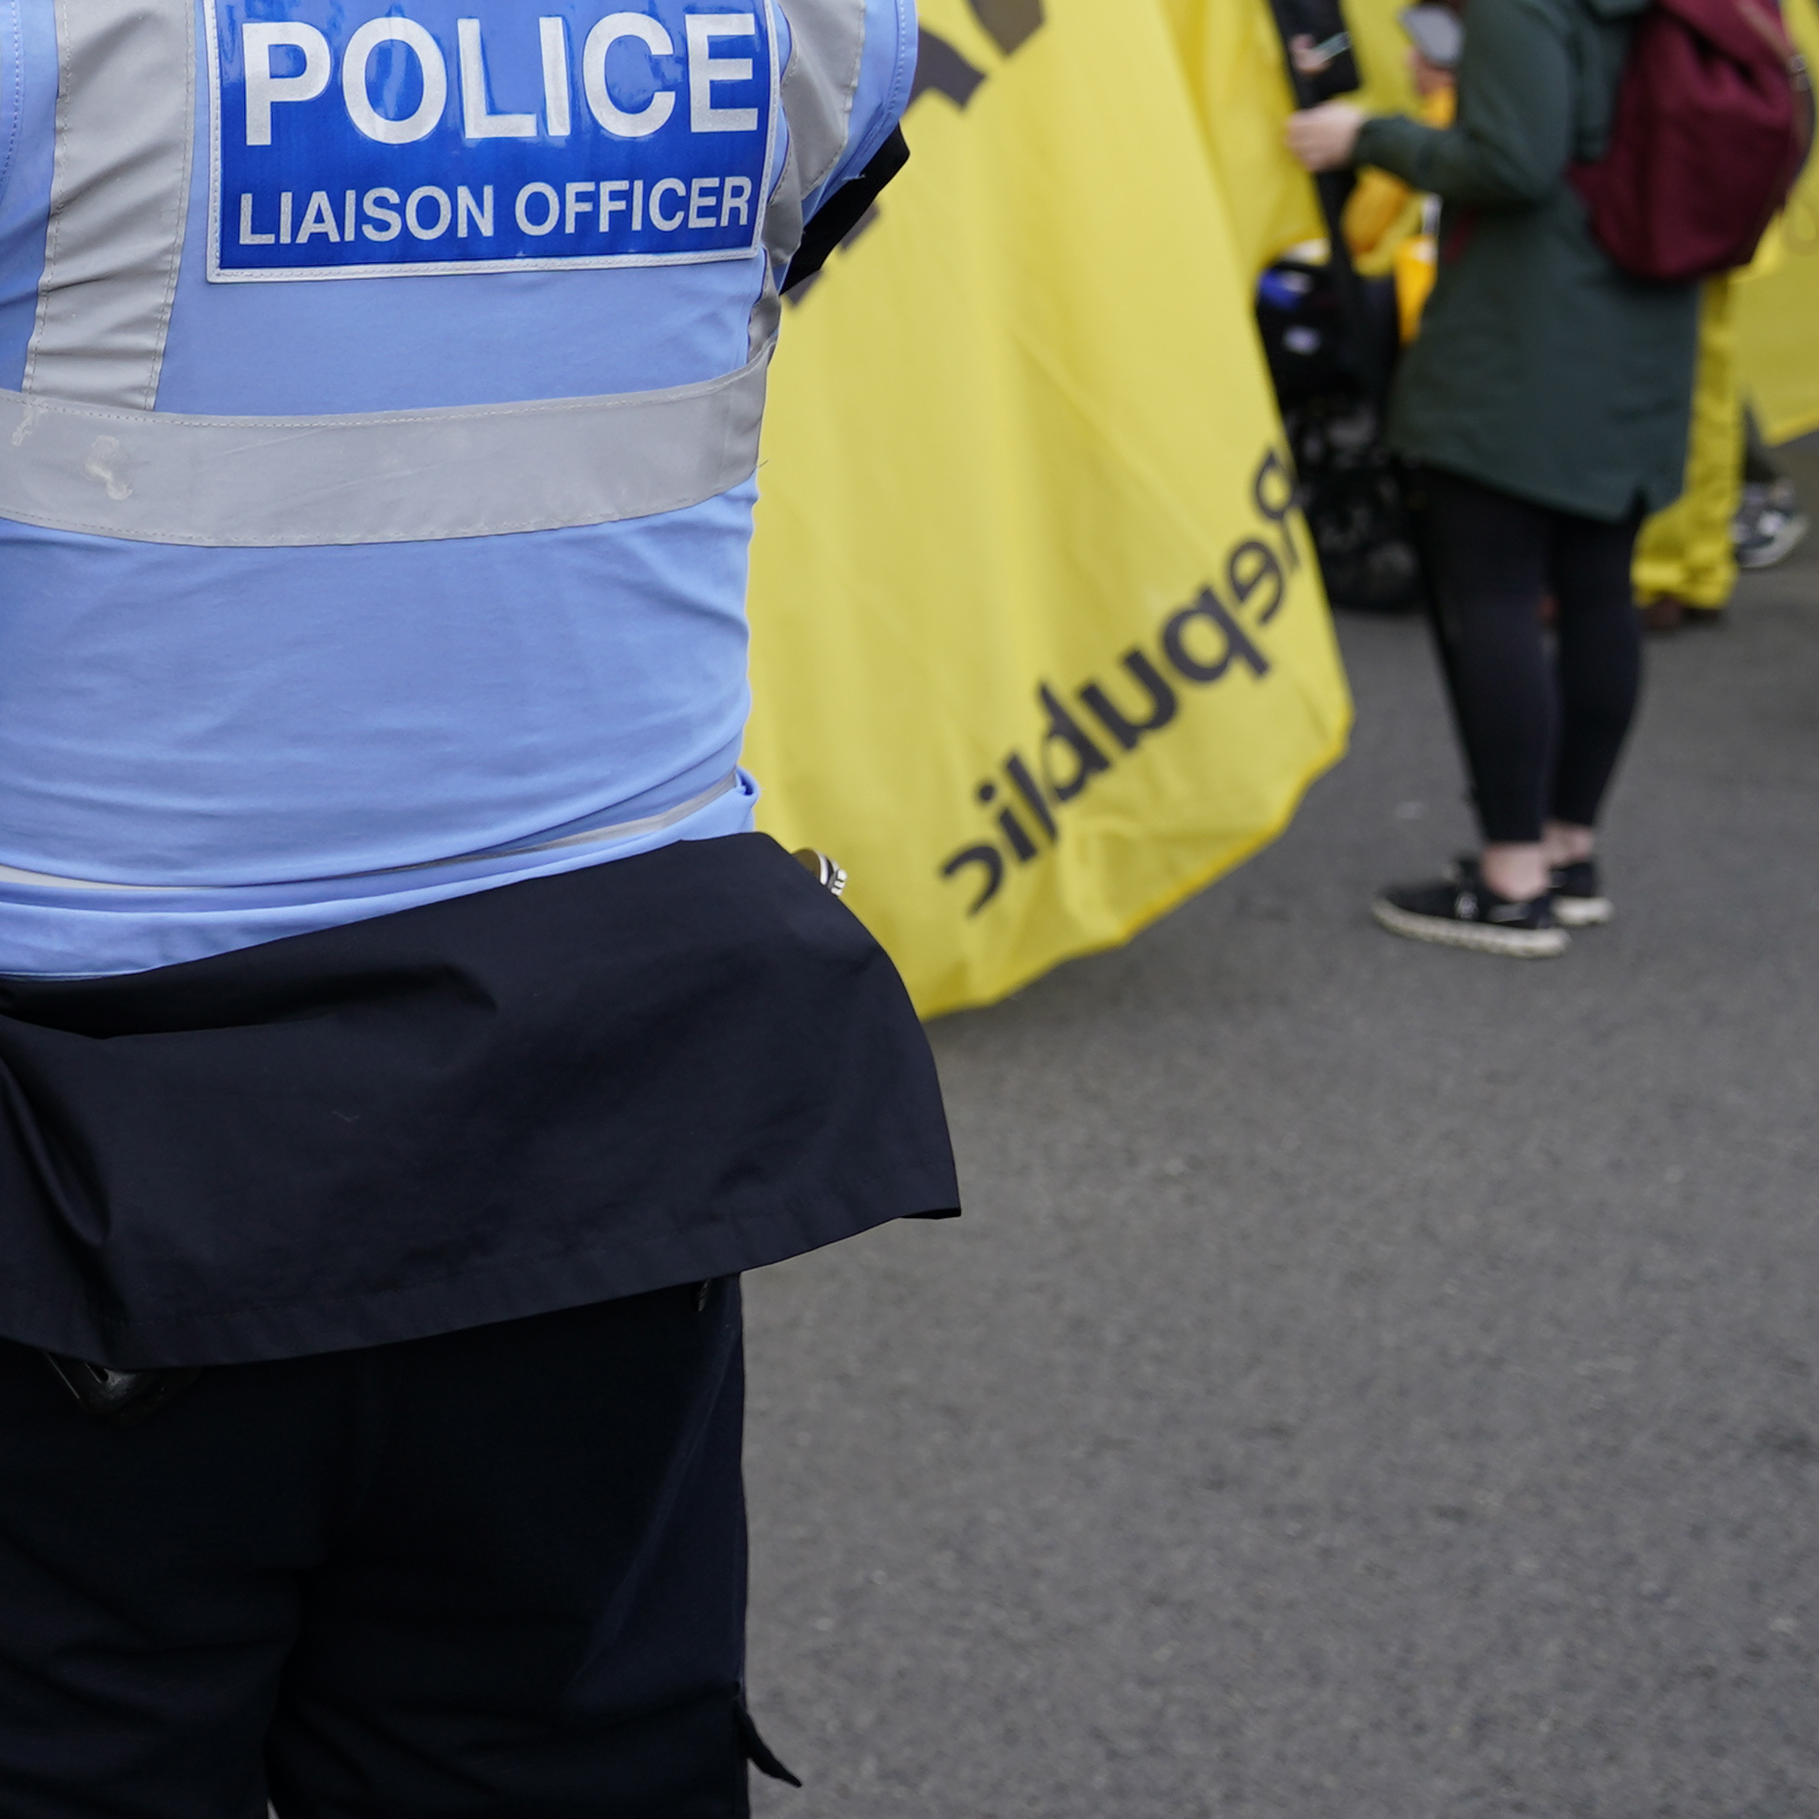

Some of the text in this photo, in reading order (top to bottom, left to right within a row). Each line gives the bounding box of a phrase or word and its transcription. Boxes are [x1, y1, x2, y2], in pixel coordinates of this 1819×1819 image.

[241, 11, 759, 147] POLICE
[238, 176, 753, 246] LIAISON OFFICER
